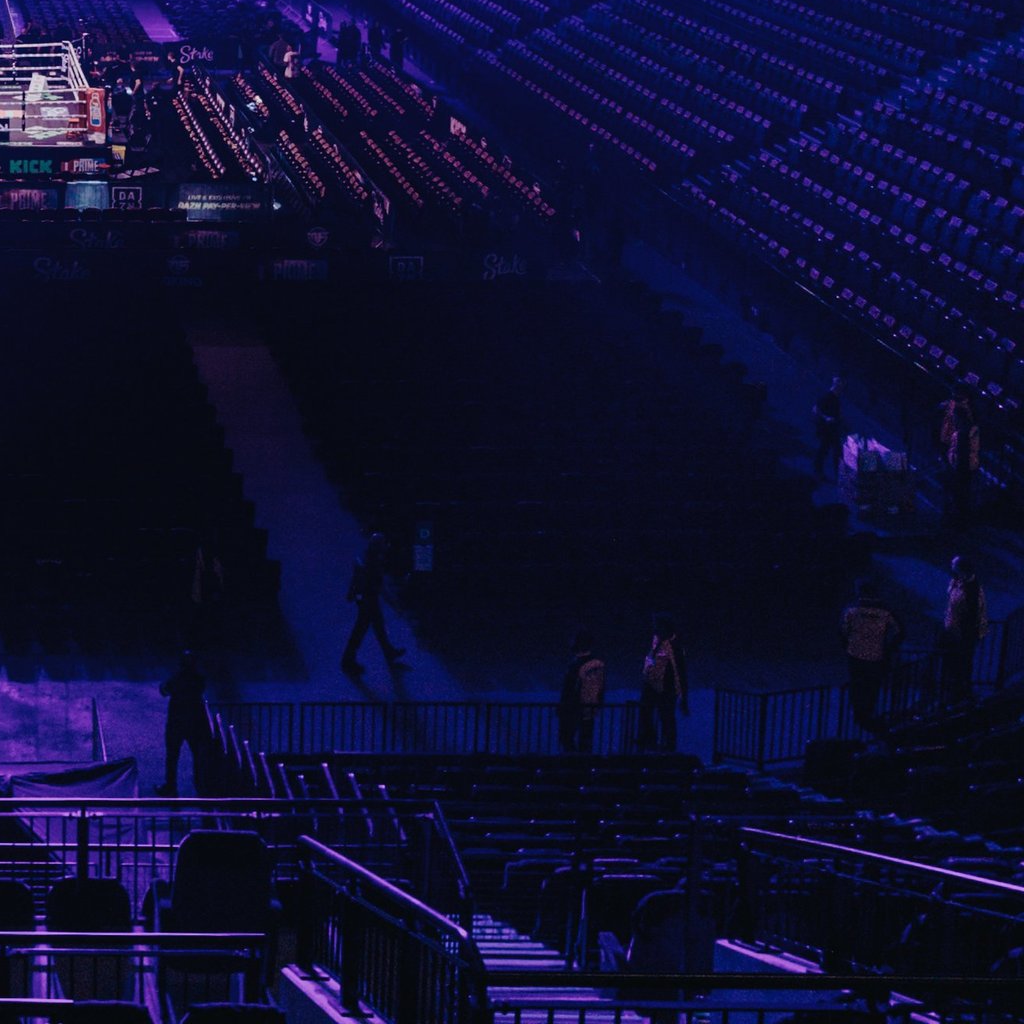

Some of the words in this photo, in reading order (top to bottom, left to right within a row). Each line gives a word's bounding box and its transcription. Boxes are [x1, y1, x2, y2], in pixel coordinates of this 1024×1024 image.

[179, 46, 214, 63] Stake
[9, 159, 53, 174] KICK
[73, 158, 98, 174] PRIME
[118, 191, 134, 200] DA
